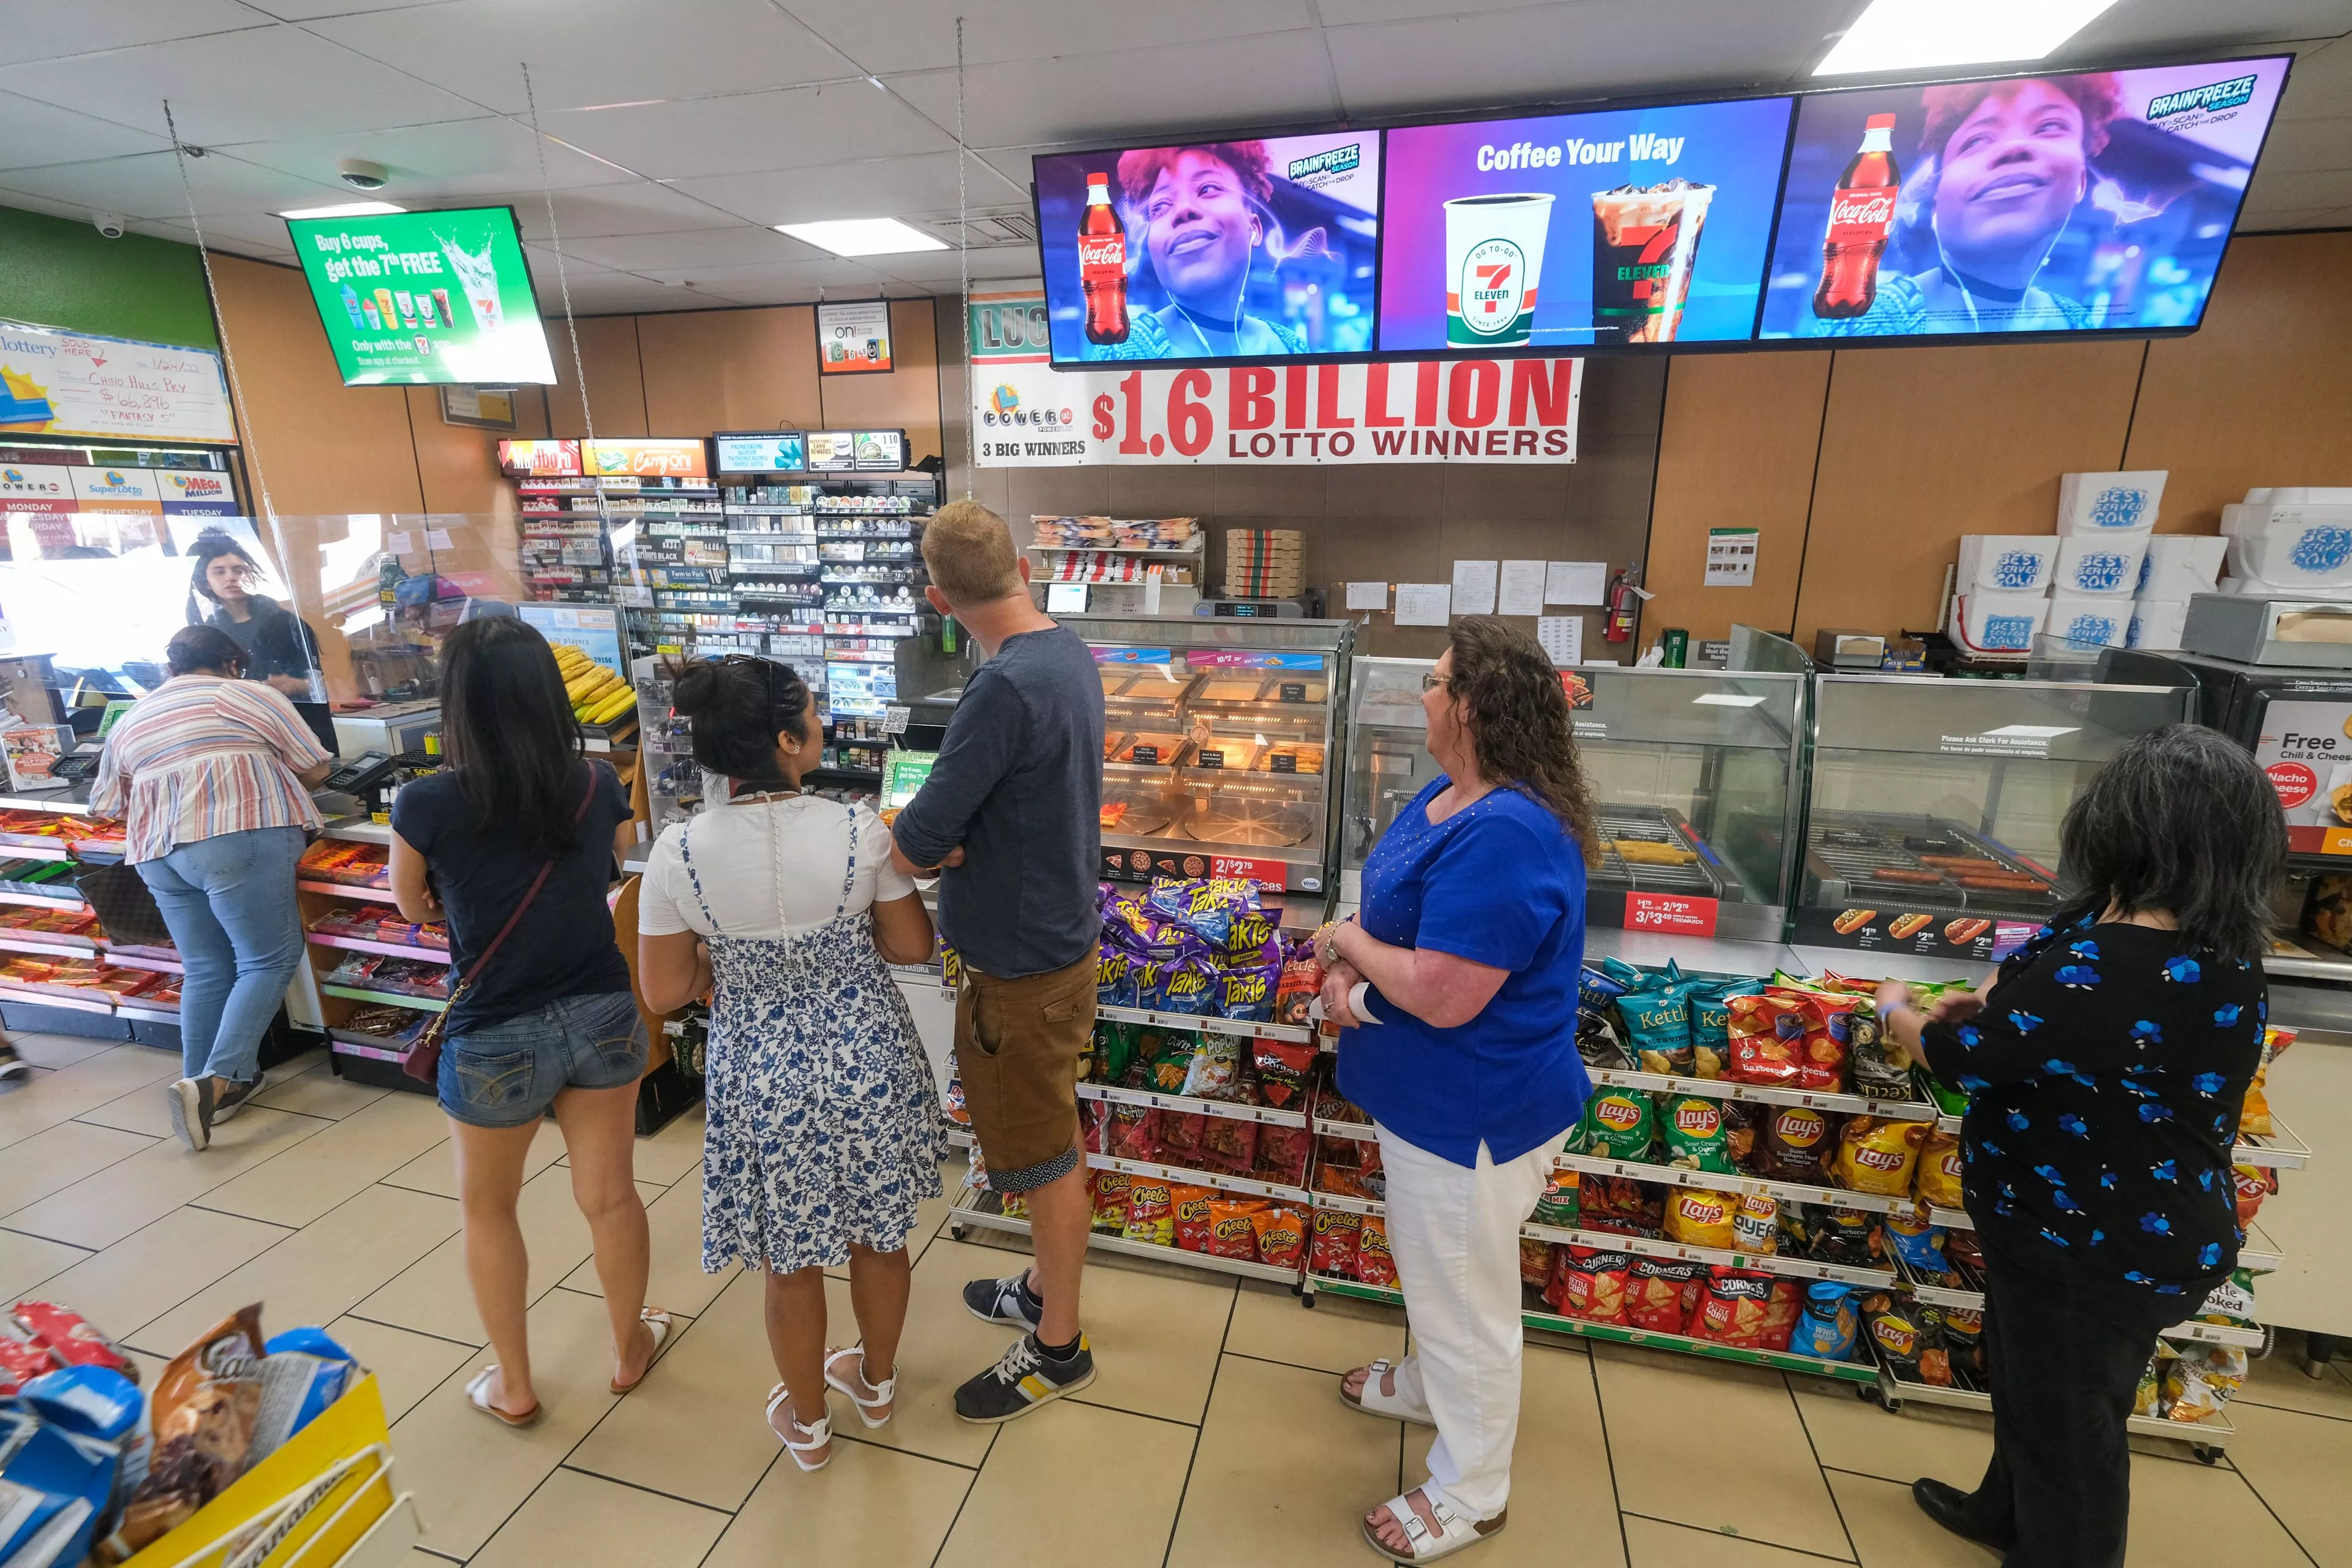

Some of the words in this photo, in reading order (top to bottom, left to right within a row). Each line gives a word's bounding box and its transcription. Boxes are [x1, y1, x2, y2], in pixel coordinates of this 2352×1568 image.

[2149, 75, 2255, 119] BRAINFREEZE
[2208, 94, 2249, 111] SEASON
[2147, 120, 2168, 131] BUY
[2173, 113, 2199, 126] SCAN
[2166, 121, 2199, 134] CATCH
[2210, 112, 2237, 124] DROP
[1477, 143, 1561, 172] Coffee
[1566, 138, 1625, 166] Your
[1629, 132, 1686, 167] Way
[1289, 144, 1359, 179] BRAINFREEZE
[1332, 159, 1358, 173] SEASON
[1292, 180, 1306, 189] BUY
[1309, 175, 1327, 184] SCAN
[1306, 181, 1328, 191] CATCH
[1336, 174, 1354, 183] DROP
[1833, 197, 1893, 225] Coca-Cola
[314, 233, 341, 254] Buy
[341, 233, 351, 251] 6
[352, 235, 389, 252] cups,
[1083, 243, 1123, 265] Coca-Cola
[1476, 249, 1487, 258] OG
[1489, 246, 1514, 257] TO-GO
[325, 258, 351, 283] get
[351, 256, 381, 277] the
[378, 252, 400, 276] 7th
[399, 251, 443, 275] FREE
[1472, 316, 1490, 327] SINCE
[835, 326, 856, 338] on!
[62, 338, 90, 348] SOLD
[352, 340, 374, 353] Only
[373, 339, 394, 351] with
[395, 339, 412, 350] the
[65, 347, 91, 356] HERE
[153, 358, 201, 372] 1/24/22
[357, 356, 372, 366] Scan
[373, 357, 384, 367] app
[1092, 369, 1213, 458] $1.6
[1229, 359, 1573, 430] BILLION
[983, 443, 991, 456] 3
[995, 443, 1020, 456] BIG
[1025, 441, 1085, 456] WINNERS
[1229, 431, 1355, 458] LOTTO
[1371, 429, 1568, 457] WINNERS
[514, 447, 571, 469] Marlboro
[634, 451, 669, 475] Carry
[89, 484, 142, 495] SuperLotto
[186, 477, 221, 490] MEGA
[2098, 490, 2148, 503] BEST
[7, 503, 53, 511] MONDAY
[2095, 503, 2144, 511] SERVED
[2094, 511, 2142, 524] COLD
[1999, 553, 2043, 565] BEST
[2081, 554, 2130, 567] BEST
[1997, 565, 2040, 574] SERVED
[2078, 567, 2125, 575] SERVED
[1997, 573, 2037, 586] COLD
[2078, 575, 2125, 588] COLD
[1991, 621, 2026, 630] BEST
[2071, 617, 2117, 629] BEST
[1986, 636, 2023, 645] COLD
[2282, 733, 2336, 750] Free
[889, 752, 906, 761] ENTER
[908, 752, 923, 762] YOUR
[2280, 751, 2303, 760] Chili
[2268, 772, 2307, 783] Nacho
[1223, 975, 1266, 1008] Takis
[1578, 986, 1611, 1007] ettle
[1639, 1004, 1689, 1030] Kettle
[1261, 1054, 1300, 1077] Doritos
[1599, 1102, 1638, 1124] Lay's
[1679, 1109, 1717, 1131] Lay's
[1779, 1115, 1822, 1139] Lay's
[1611, 1137, 1627, 1145] Onion
[1615, 1133, 1634, 1141] Cream
[1776, 1151, 1803, 1160] Southern
[1783, 1156, 1811, 1166] Barbecue
[1857, 1148, 1902, 1172] Lay's
[1133, 1186, 1170, 1207] Cheetos
[1552, 1196, 1570, 1205] MIX
[1681, 1199, 1722, 1224] Lay's
[1744, 1196, 1774, 1215] Lay's
[1216, 1218, 1253, 1240] Cheeto
[1315, 1212, 1362, 1234] Cheetos
[1328, 1227, 1351, 1237] Crunchy
[1838, 1228, 1868, 1237] Barbecue
[1259, 1231, 1299, 1253] Cheetos
[1272, 1244, 1293, 1255] Crunchy
[1569, 1276, 1589, 1289] KETTLE
[1568, 1283, 1588, 1297] CORN
[1708, 1300, 1730, 1316] KETTLE
[2206, 1294, 2243, 1312] oked
[1706, 1308, 1728, 1322] CORN
